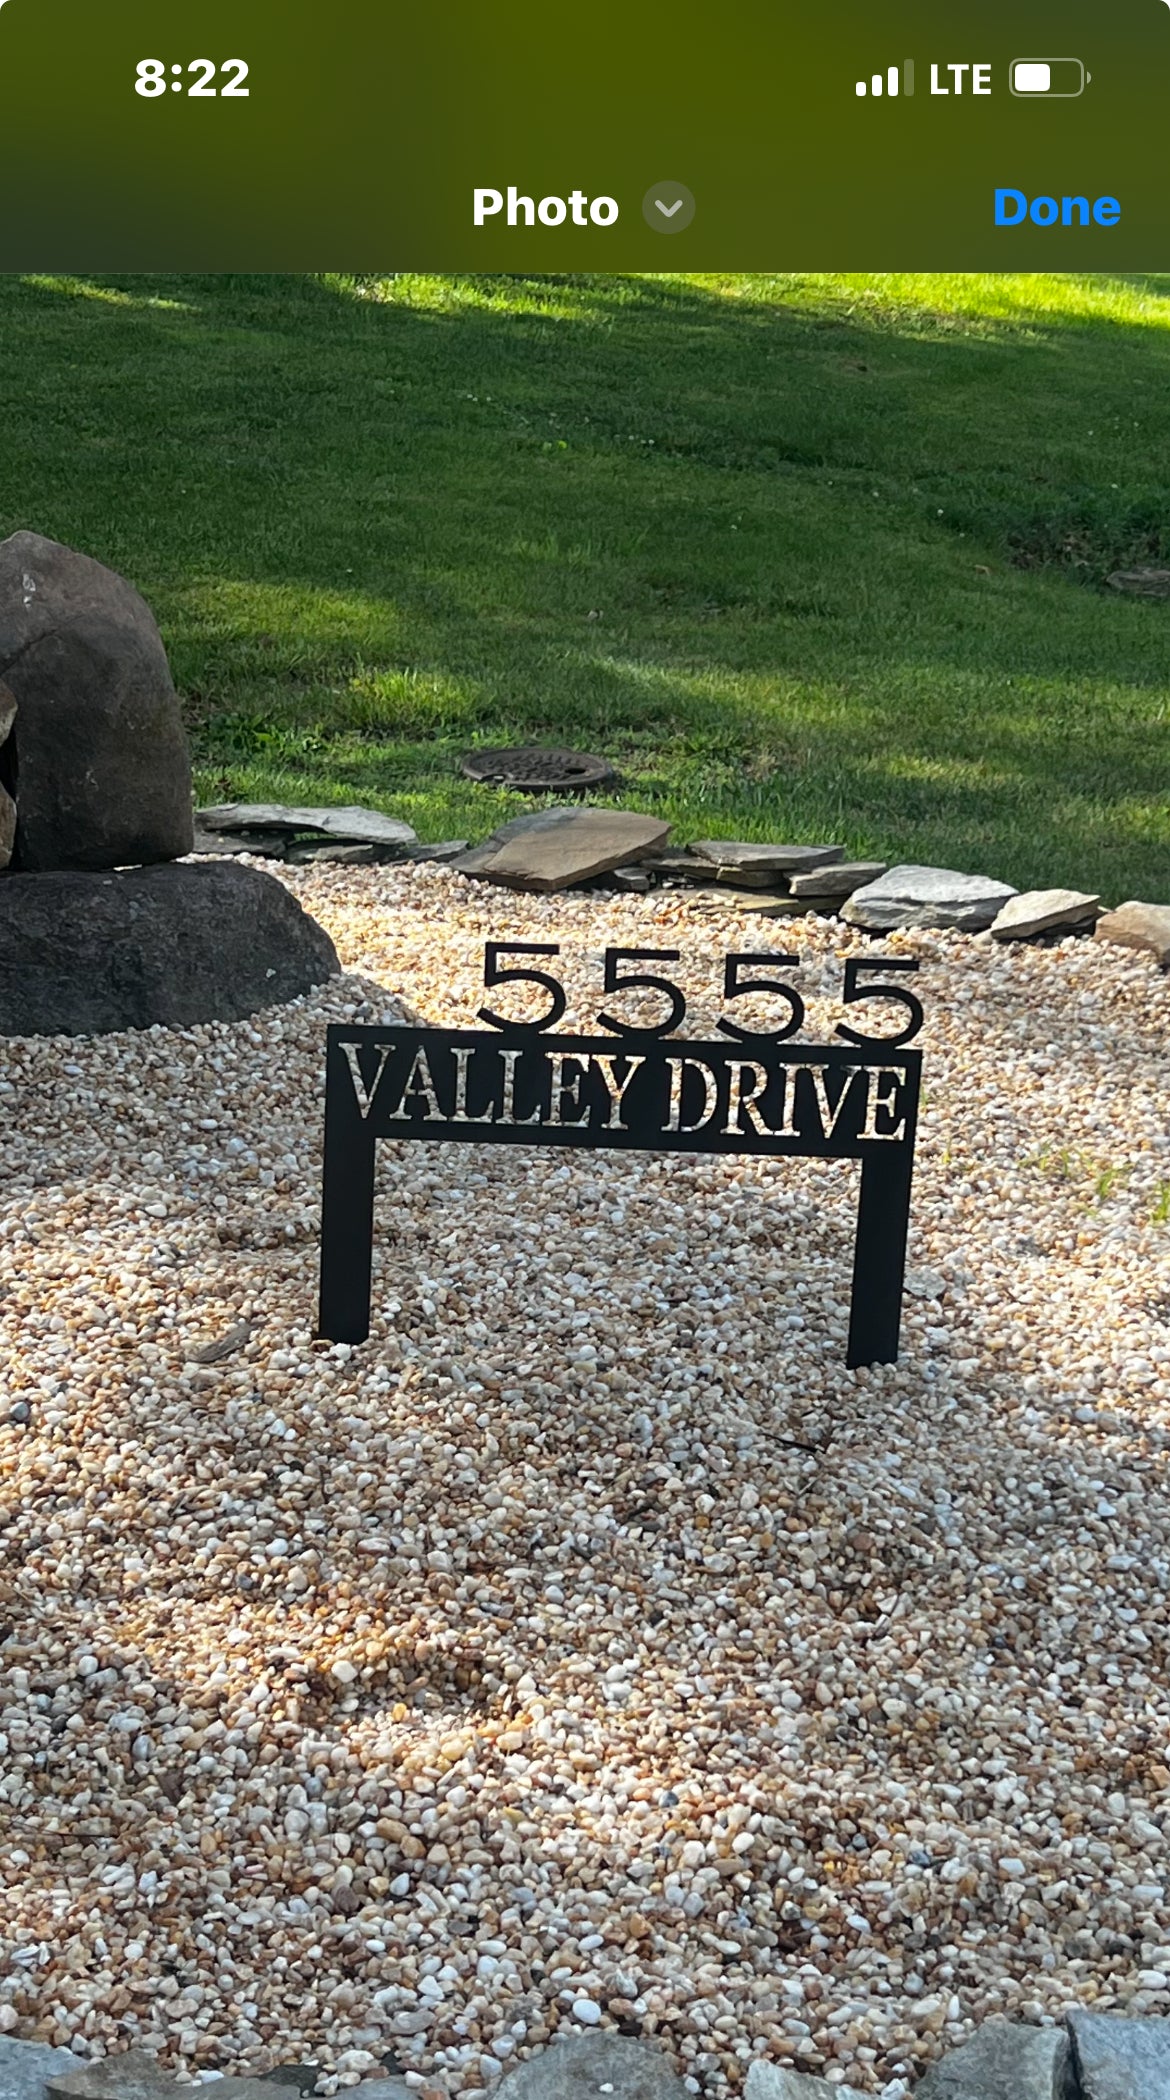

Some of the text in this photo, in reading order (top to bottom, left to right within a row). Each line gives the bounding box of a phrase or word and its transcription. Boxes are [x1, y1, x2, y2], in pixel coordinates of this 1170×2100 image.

[476, 942, 924, 1049] 5555
[338, 1042, 908, 1142] VALLEY DRIVE
